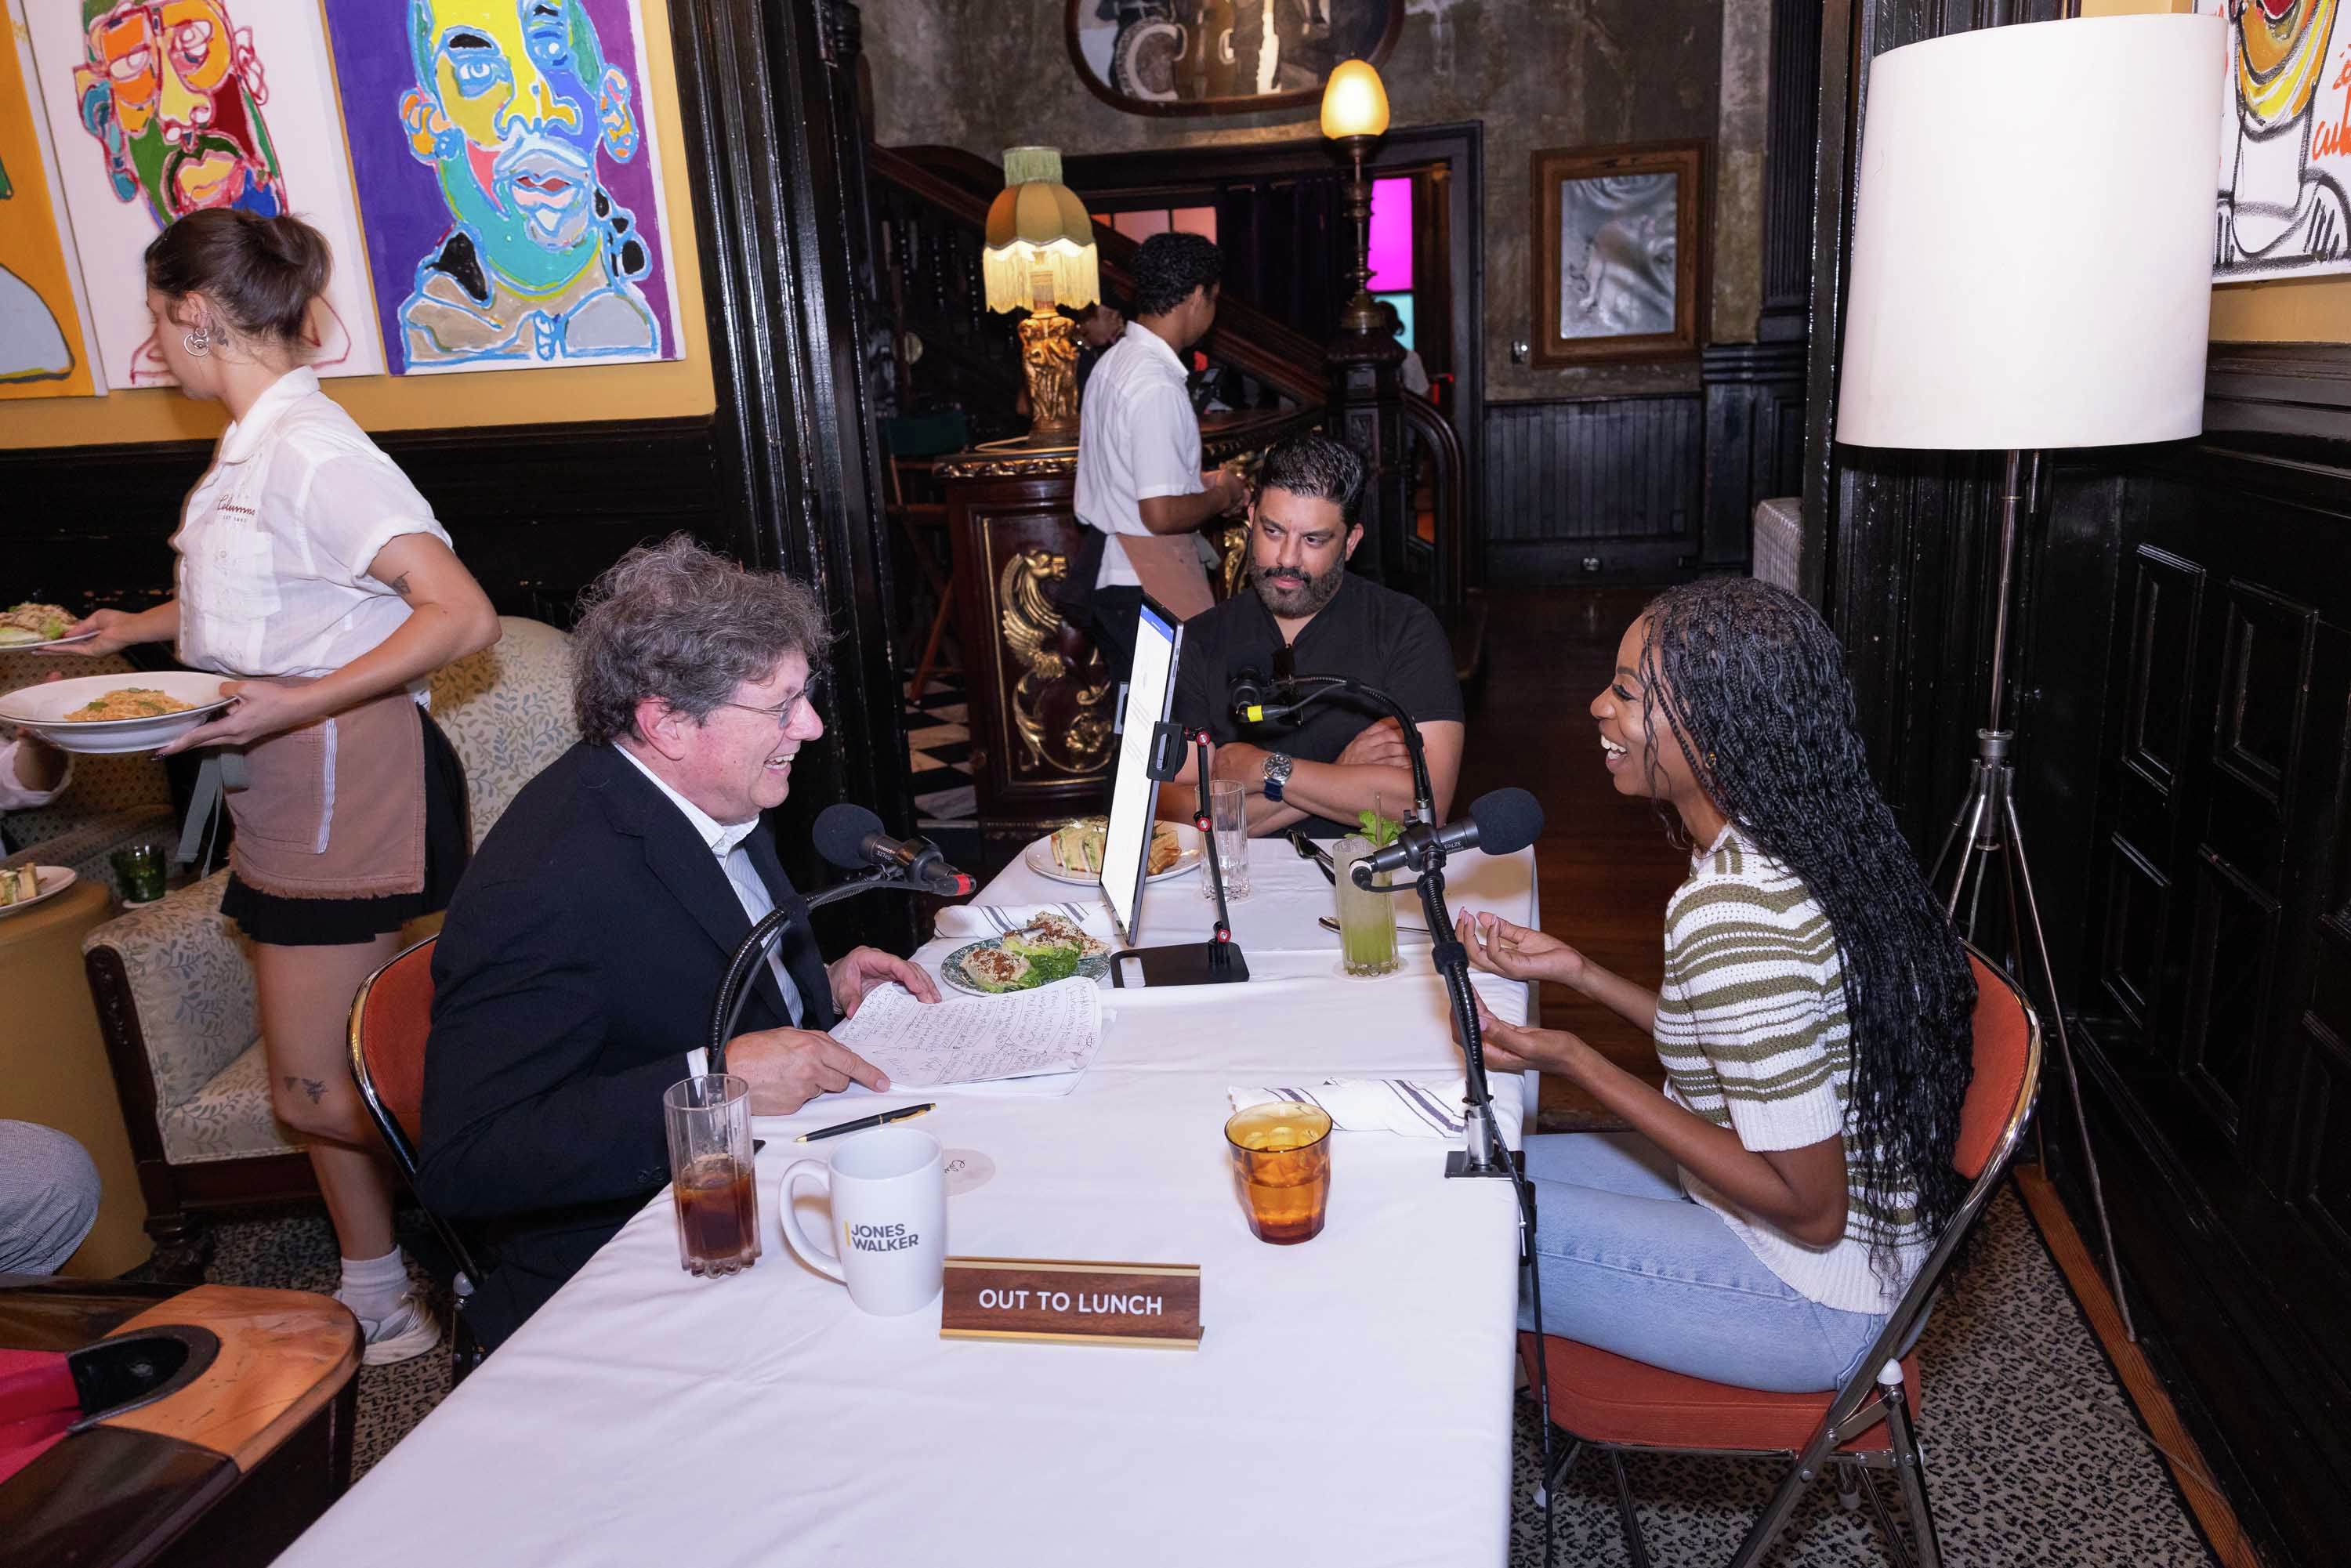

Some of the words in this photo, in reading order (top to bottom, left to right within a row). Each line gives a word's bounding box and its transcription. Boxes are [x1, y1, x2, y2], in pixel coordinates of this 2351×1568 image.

[851, 1223, 905, 1238] JONES
[852, 1233, 919, 1252] WALKER
[979, 1289, 1030, 1309] OUT
[1037, 1291, 1070, 1312] TO
[1078, 1293, 1162, 1316] LUNCH
